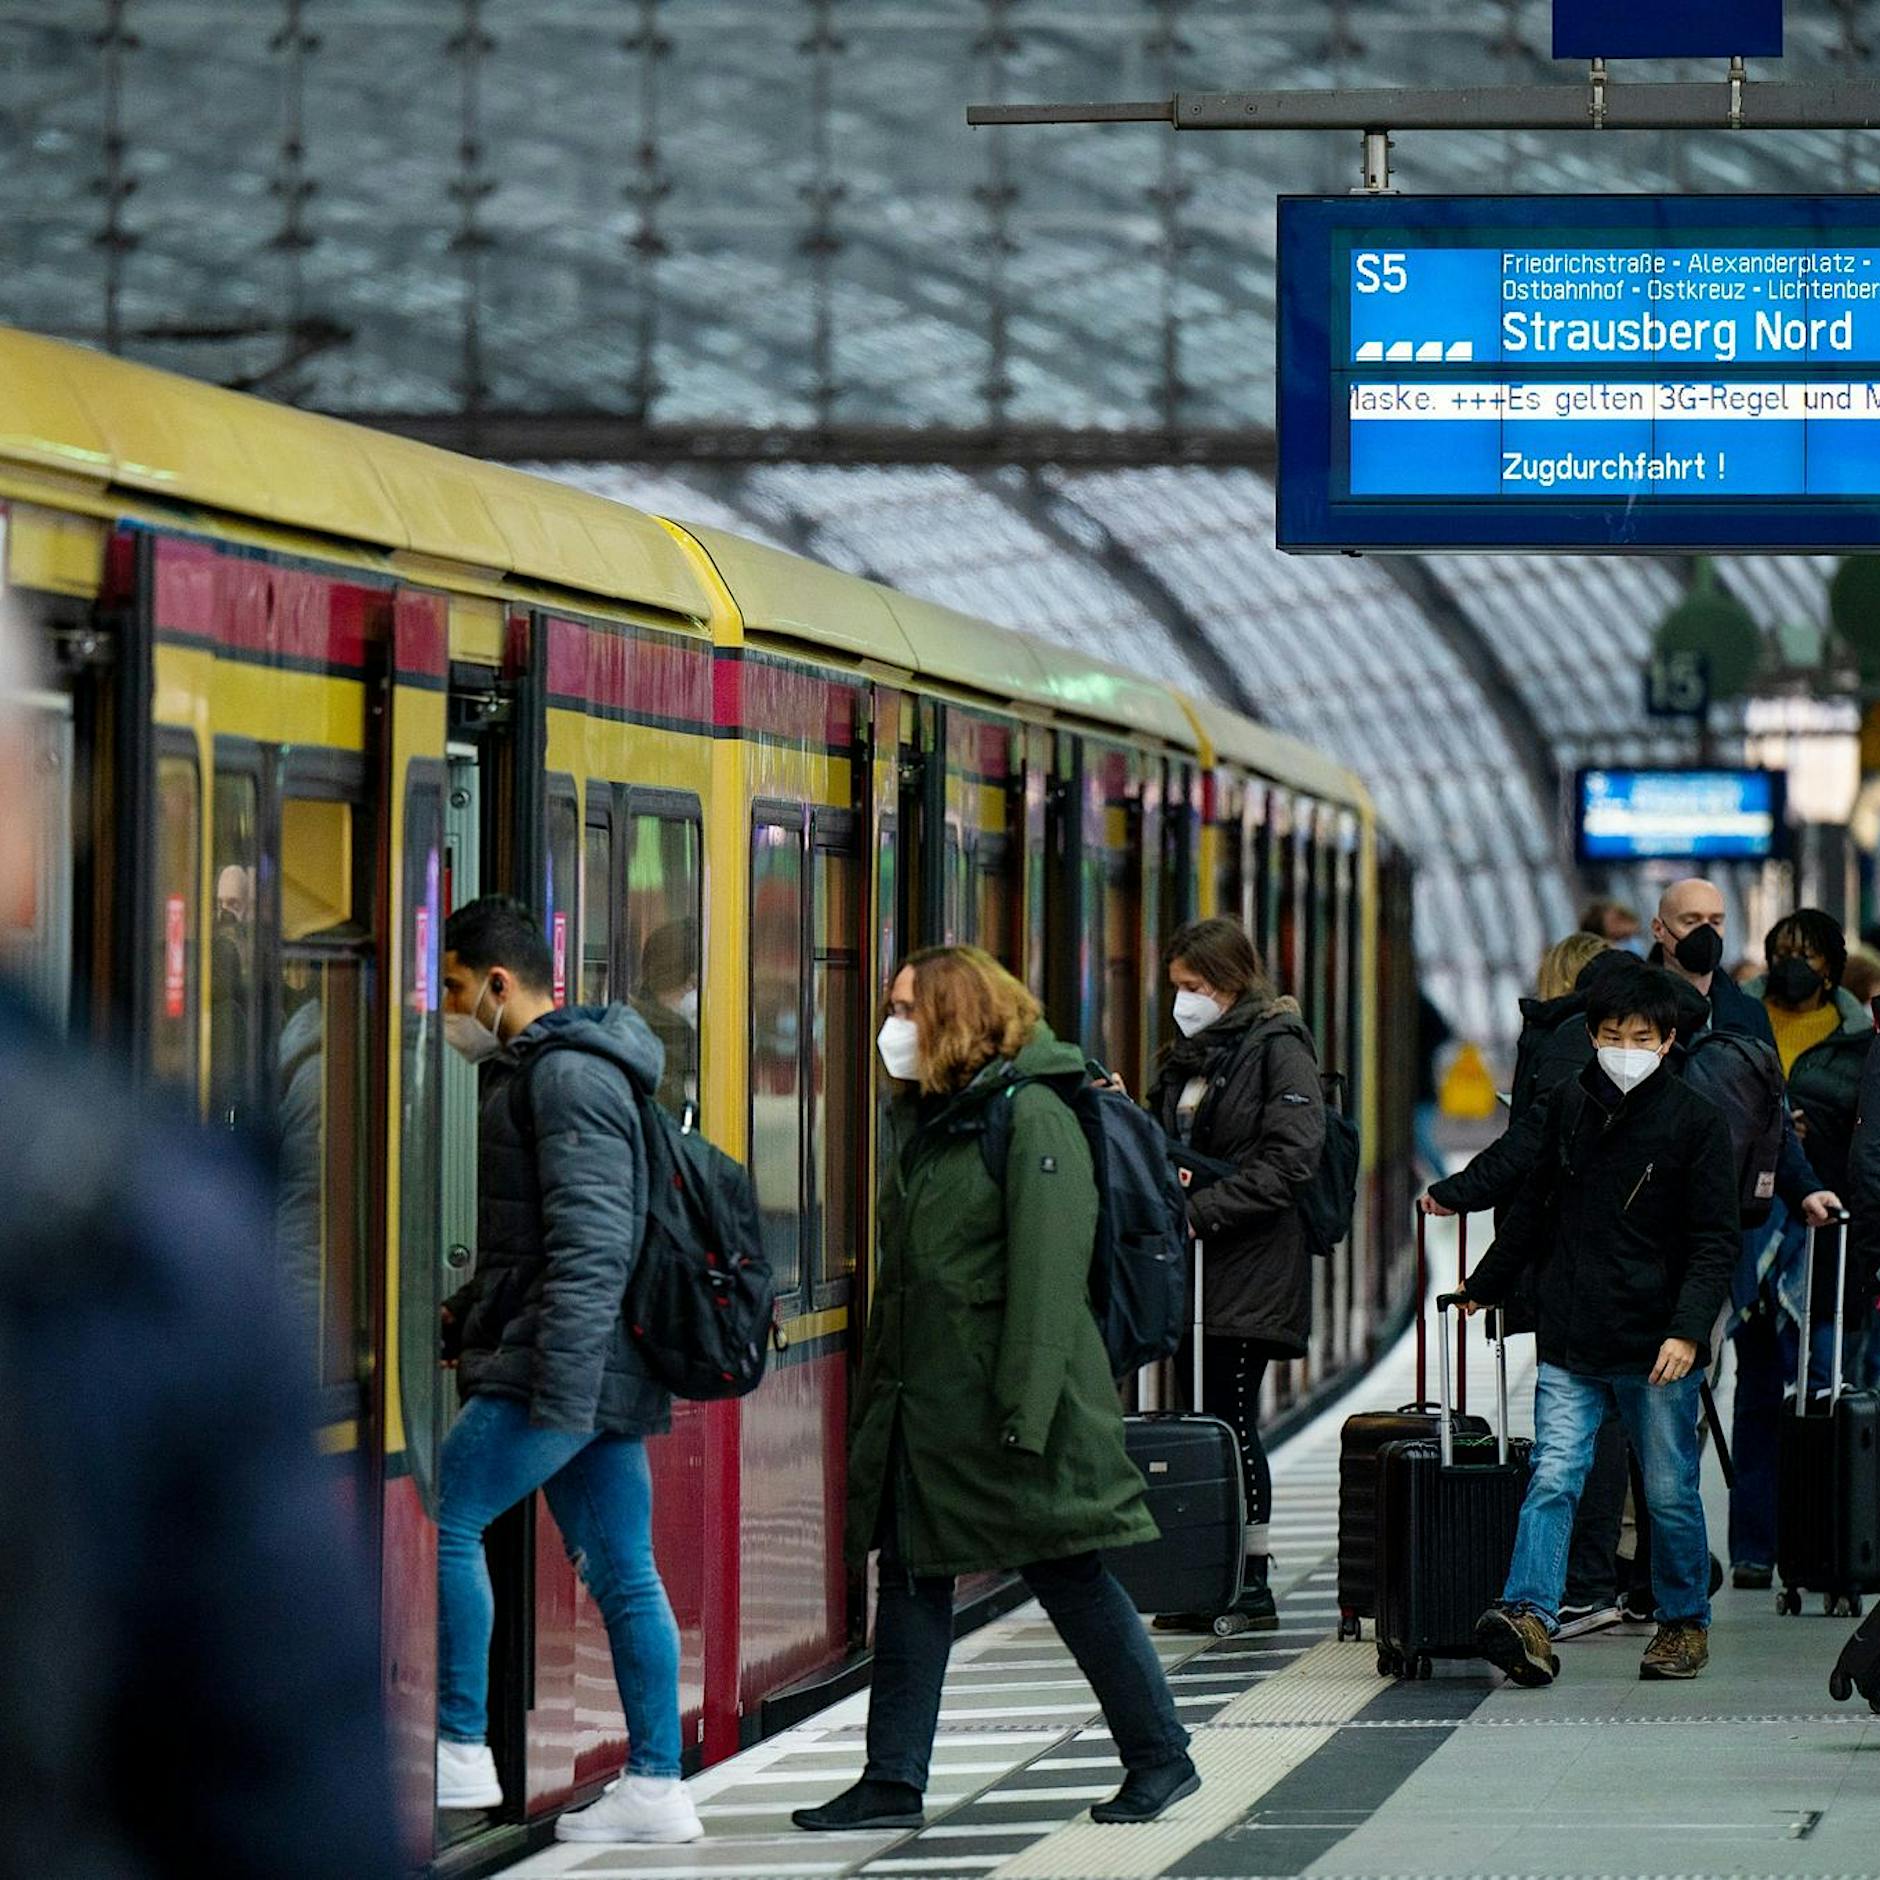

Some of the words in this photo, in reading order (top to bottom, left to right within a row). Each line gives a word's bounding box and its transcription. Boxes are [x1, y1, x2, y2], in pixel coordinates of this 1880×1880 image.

[1356, 253, 1408, 293] S5
[1502, 253, 1666, 274] Friedrichstraße
[1688, 253, 1855, 278] Alexanderplatz
[1502, 279, 1625, 301] Ostbahnhof
[1647, 279, 1746, 301] Ostkreuz
[1768, 279, 1880, 300] Lichtenber
[1502, 311, 1736, 361] Strausberg
[1755, 310, 1852, 351] Nord
[1556, 383, 1643, 417] gelten
[1659, 382, 1789, 416] 3G-Regel
[1804, 383, 1851, 410] und
[1502, 452, 1706, 487] Zugdurchfahrt
[1718, 452, 1725, 480] !
